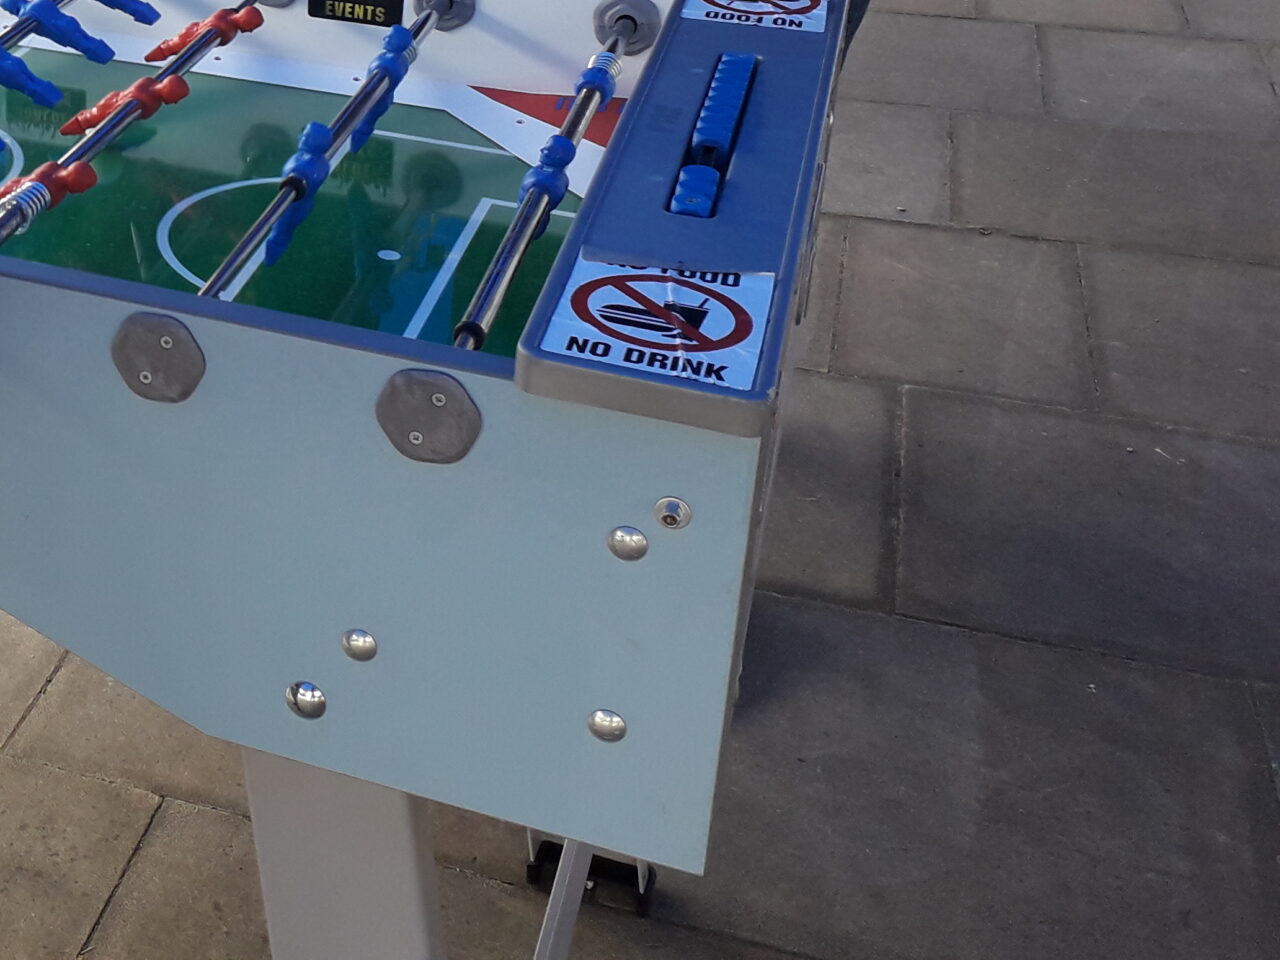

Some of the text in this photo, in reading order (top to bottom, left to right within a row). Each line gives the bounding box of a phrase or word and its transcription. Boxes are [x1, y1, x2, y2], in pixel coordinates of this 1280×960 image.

[325, 0, 386, 23] EVENTS
[704, 10, 803, 28] NO FOOD
[565, 335, 729, 382] NO DRINK
